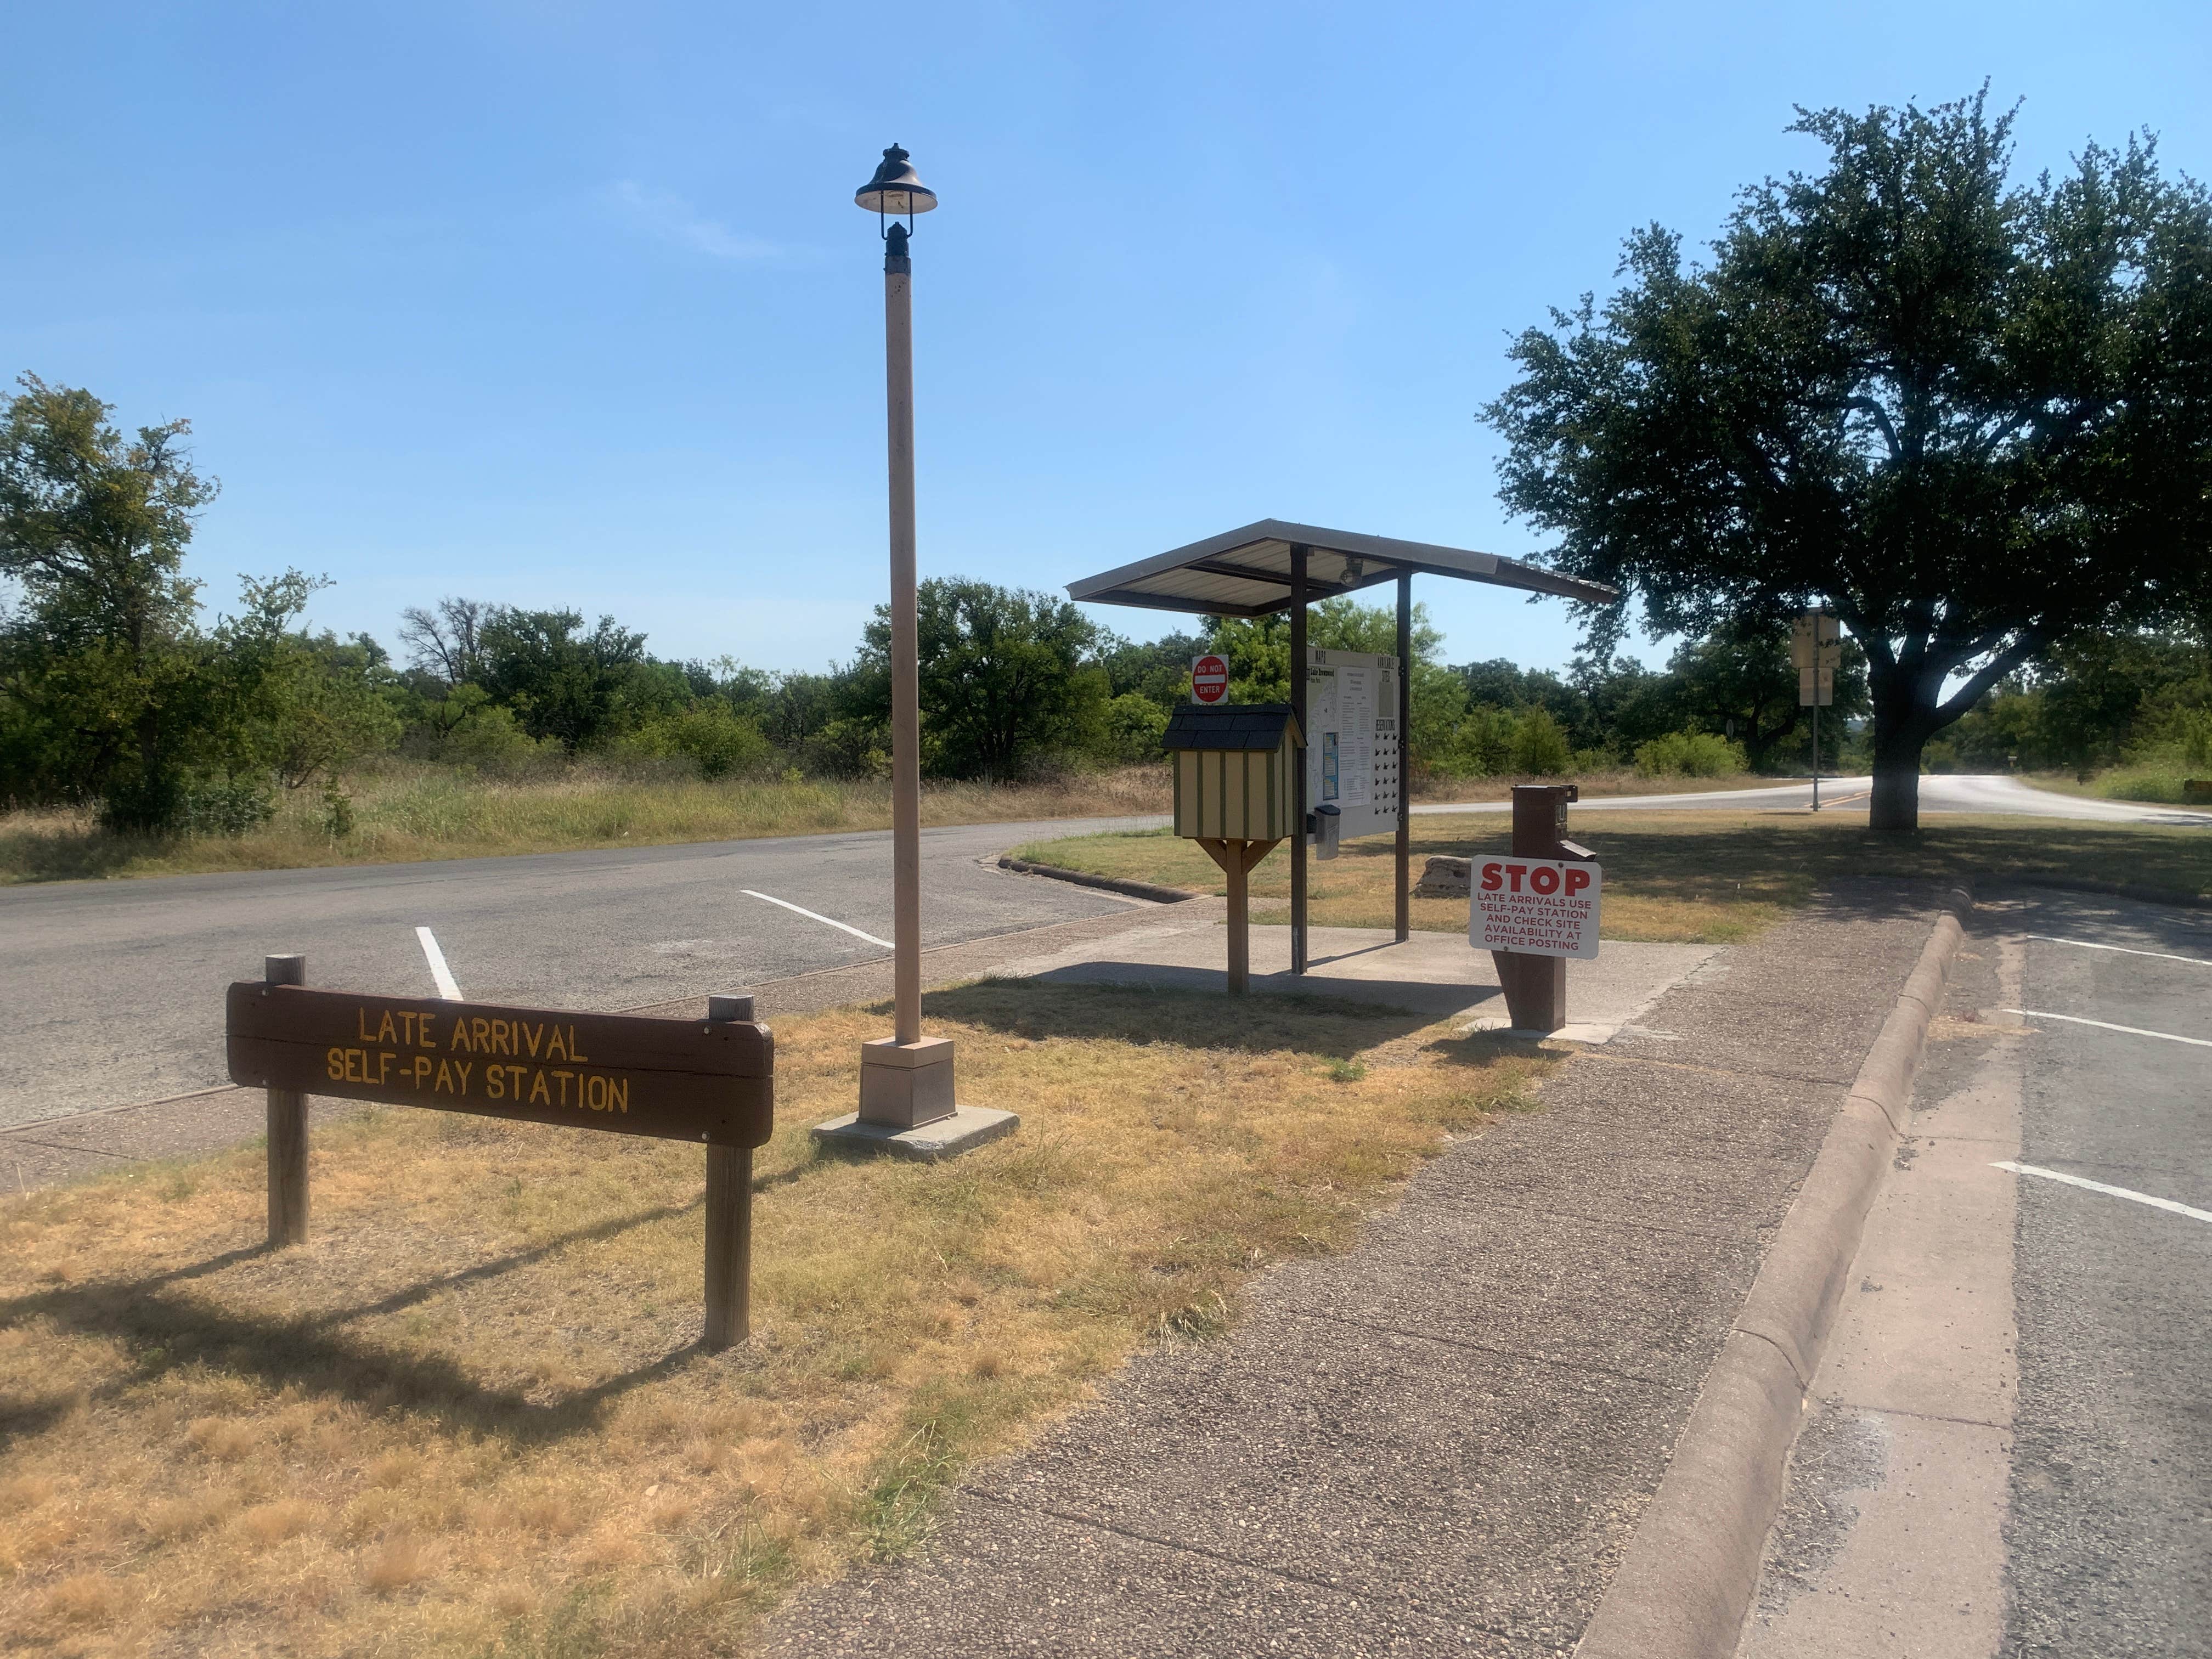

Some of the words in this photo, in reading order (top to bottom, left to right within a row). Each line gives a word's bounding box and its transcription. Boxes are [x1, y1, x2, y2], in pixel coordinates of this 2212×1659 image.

[1315, 650, 1325, 663] MAPS
[1378, 657, 1394, 669] AVAILABLE
[1318, 668, 1334, 676] Brownwood
[1375, 719, 1395, 731] RESERVATIONS
[1481, 862, 1590, 896] STOP
[1477, 893, 1505, 902] LATE
[1509, 895, 1565, 906] ARRIVALS
[1570, 900, 1591, 909] USE
[1480, 903, 1533, 915] SELF-PAY
[1537, 909, 1587, 919] STATION
[1487, 914, 1510, 923] AND
[1514, 917, 1551, 927] CHECK
[1556, 920, 1580, 929] SITE
[1485, 924, 1562, 938] AVAILABILITY
[1485, 934, 1525, 945] OFFICE
[1529, 939, 1579, 950] POSTING
[358, 1007, 437, 1048] LATE
[450, 1016, 588, 1063] ARRIVAL
[328, 1048, 472, 1096] SELF-PAY
[485, 1064, 629, 1114] STATION
